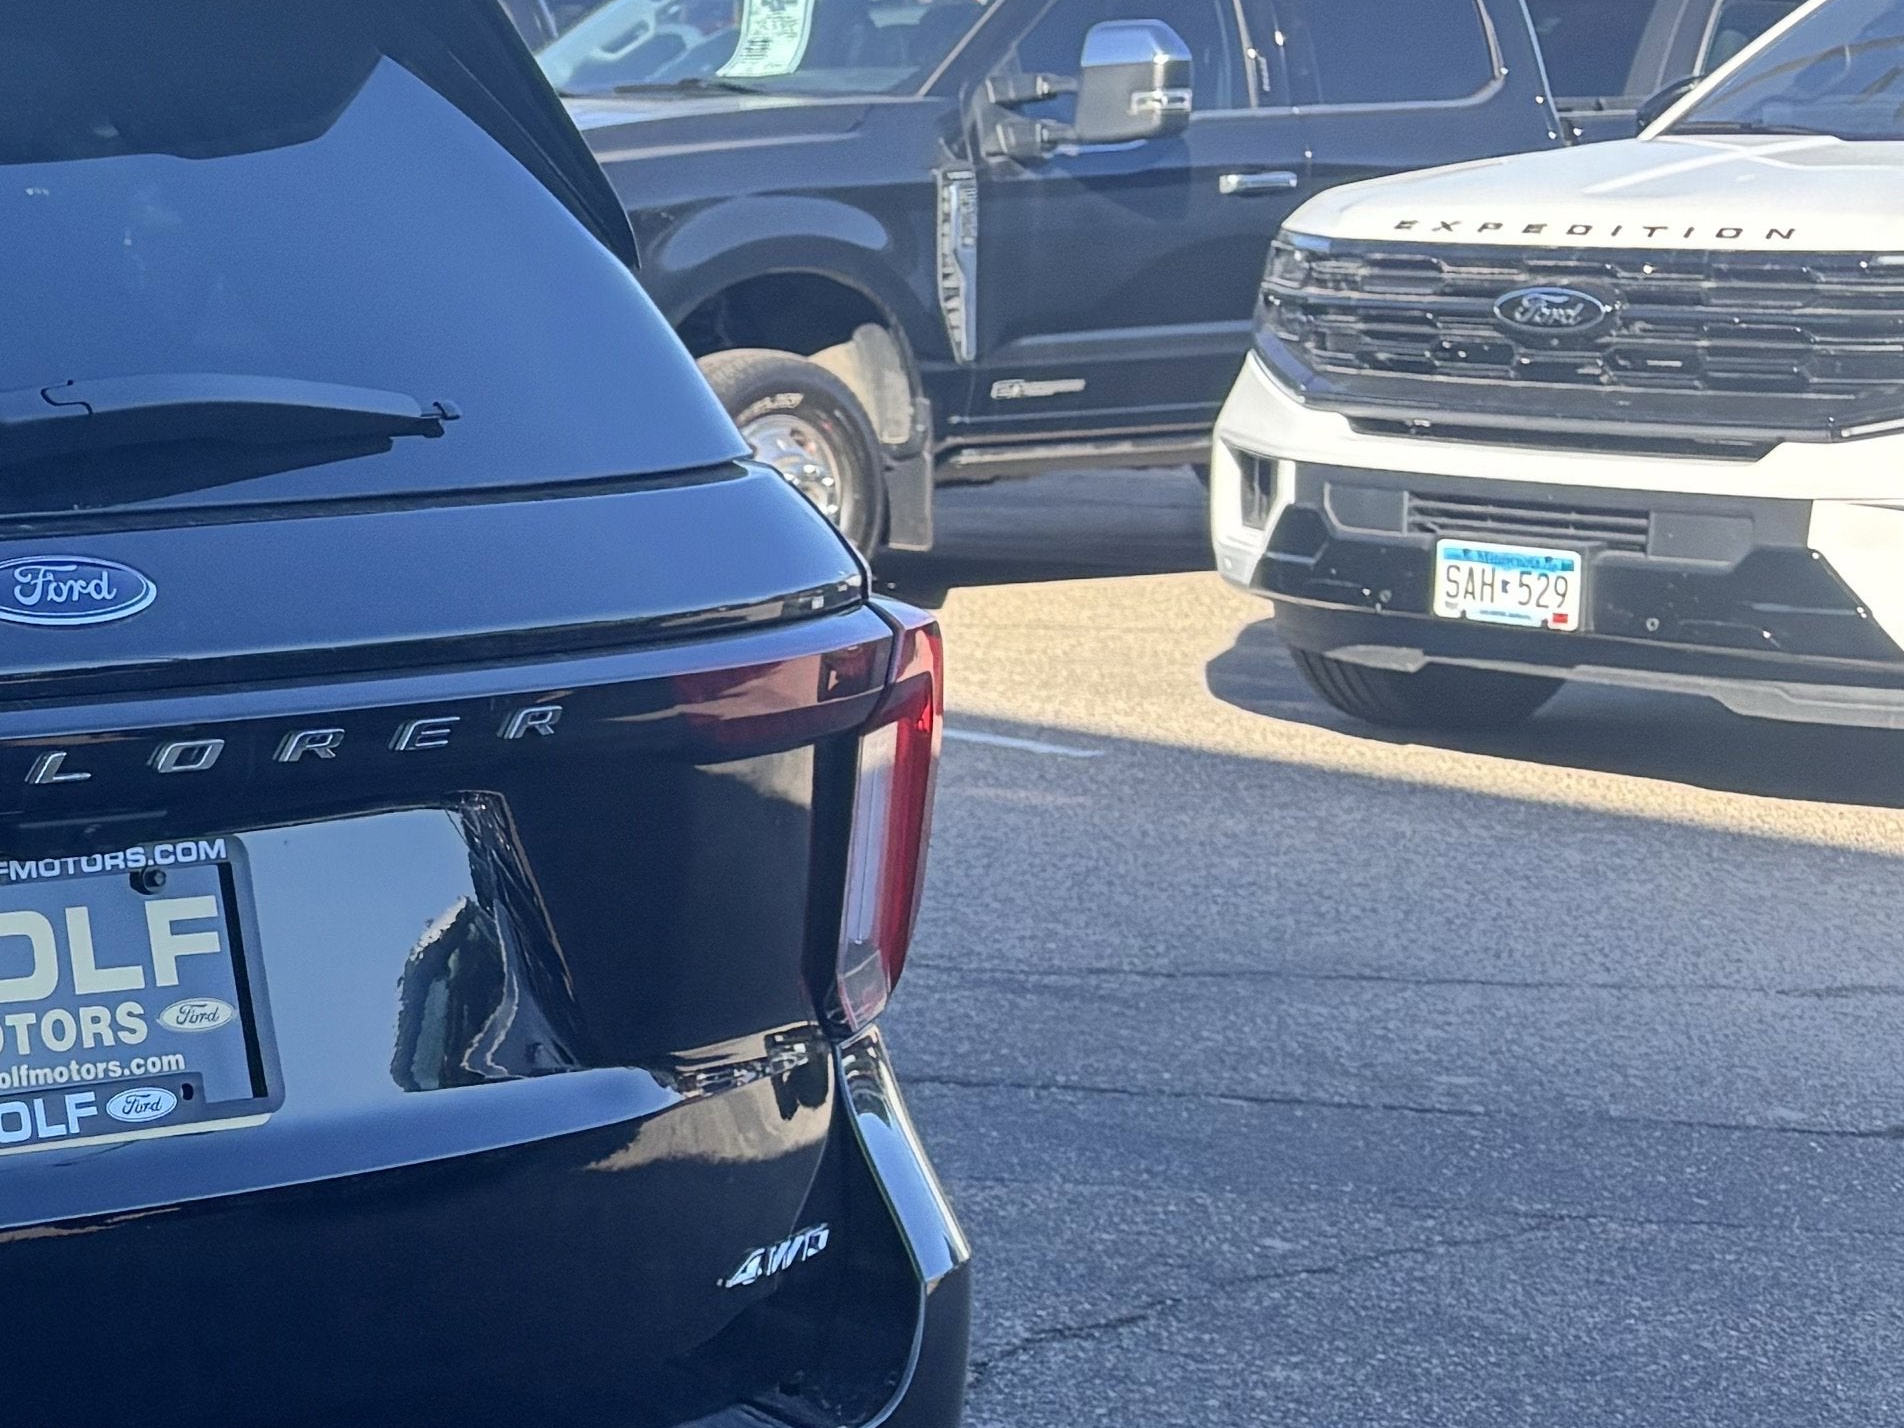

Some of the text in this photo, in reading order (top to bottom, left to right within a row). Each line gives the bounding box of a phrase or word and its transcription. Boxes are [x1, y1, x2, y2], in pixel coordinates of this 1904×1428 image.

[1393, 220, 1796, 240] EXPEDITION
[1512, 292, 1584, 325] Ford
[13, 563, 117, 606] Ford
[1445, 564, 1569, 609] SAH 529
[724, 1223, 830, 1288] 4WD
